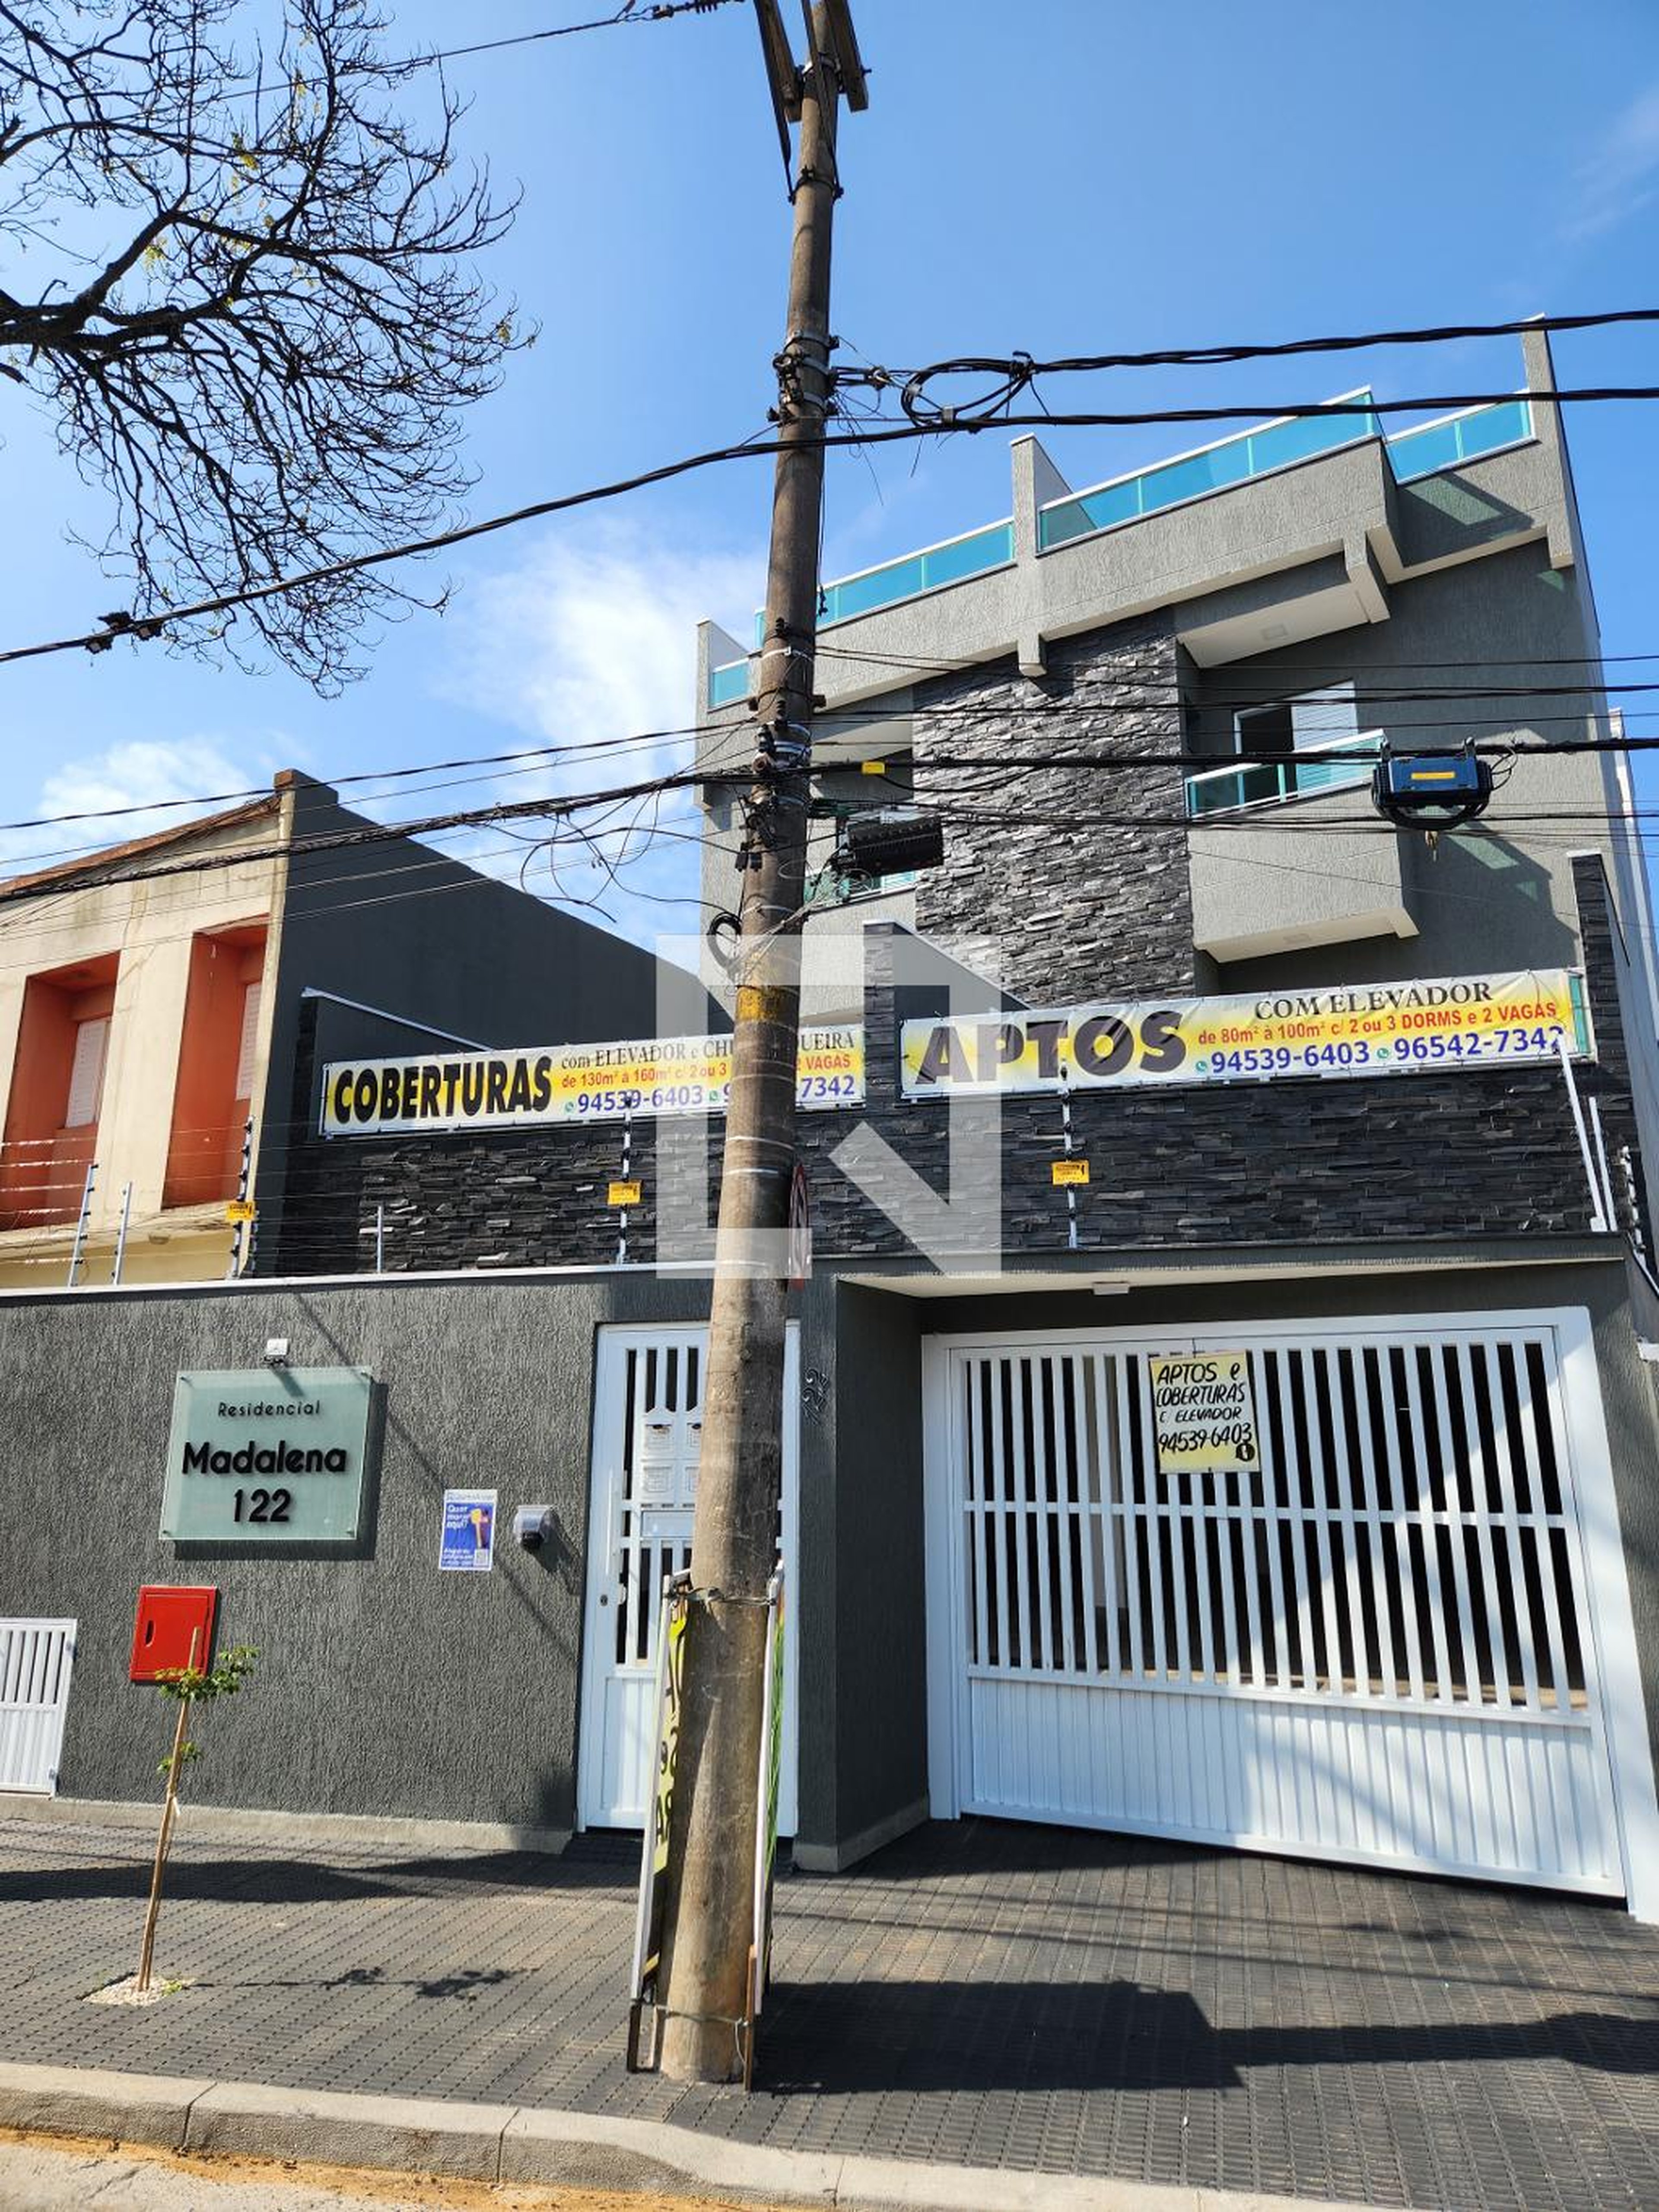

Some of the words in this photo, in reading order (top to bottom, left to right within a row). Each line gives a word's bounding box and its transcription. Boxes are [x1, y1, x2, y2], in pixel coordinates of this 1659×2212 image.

[1255, 996, 1321, 1019] COM
[1330, 982, 1493, 1014] ELEVADOR
[1198, 1030, 1216, 1044] de
[1349, 1019, 1358, 1033] 2
[1363, 1019, 1382, 1032] ou
[1387, 1016, 1395, 1031] 3
[1402, 1010, 1462, 1029] DORMS
[1468, 1012, 1477, 1024] e
[1483, 1008, 1492, 1022] 2
[1498, 1003, 1556, 1021] VAGAS
[562, 1056, 590, 1069] com
[596, 1043, 686, 1067] ELEVADOR
[915, 1011, 1186, 1084] APTOS
[1211, 1041, 1370, 1073] 94539-6403
[562, 1074, 576, 1088] de
[690, 1064, 697, 1078] 2
[700, 1067, 715, 1077] ou
[719, 1062, 727, 1076] 3
[806, 1054, 851, 1070] VAGAS
[334, 1056, 552, 1124] COBERTURAS
[578, 1085, 702, 1113] 94539-6403
[1156, 1362, 1218, 1385] APTOS
[1230, 1363, 1240, 1380] e
[218, 1400, 320, 1417] Residencial
[1157, 1382, 1245, 1407] COBERTURAS
[1176, 1407, 1242, 1423] ELEVADOR
[182, 1440, 347, 1474] Madalena
[234, 1489, 292, 1522] 122
